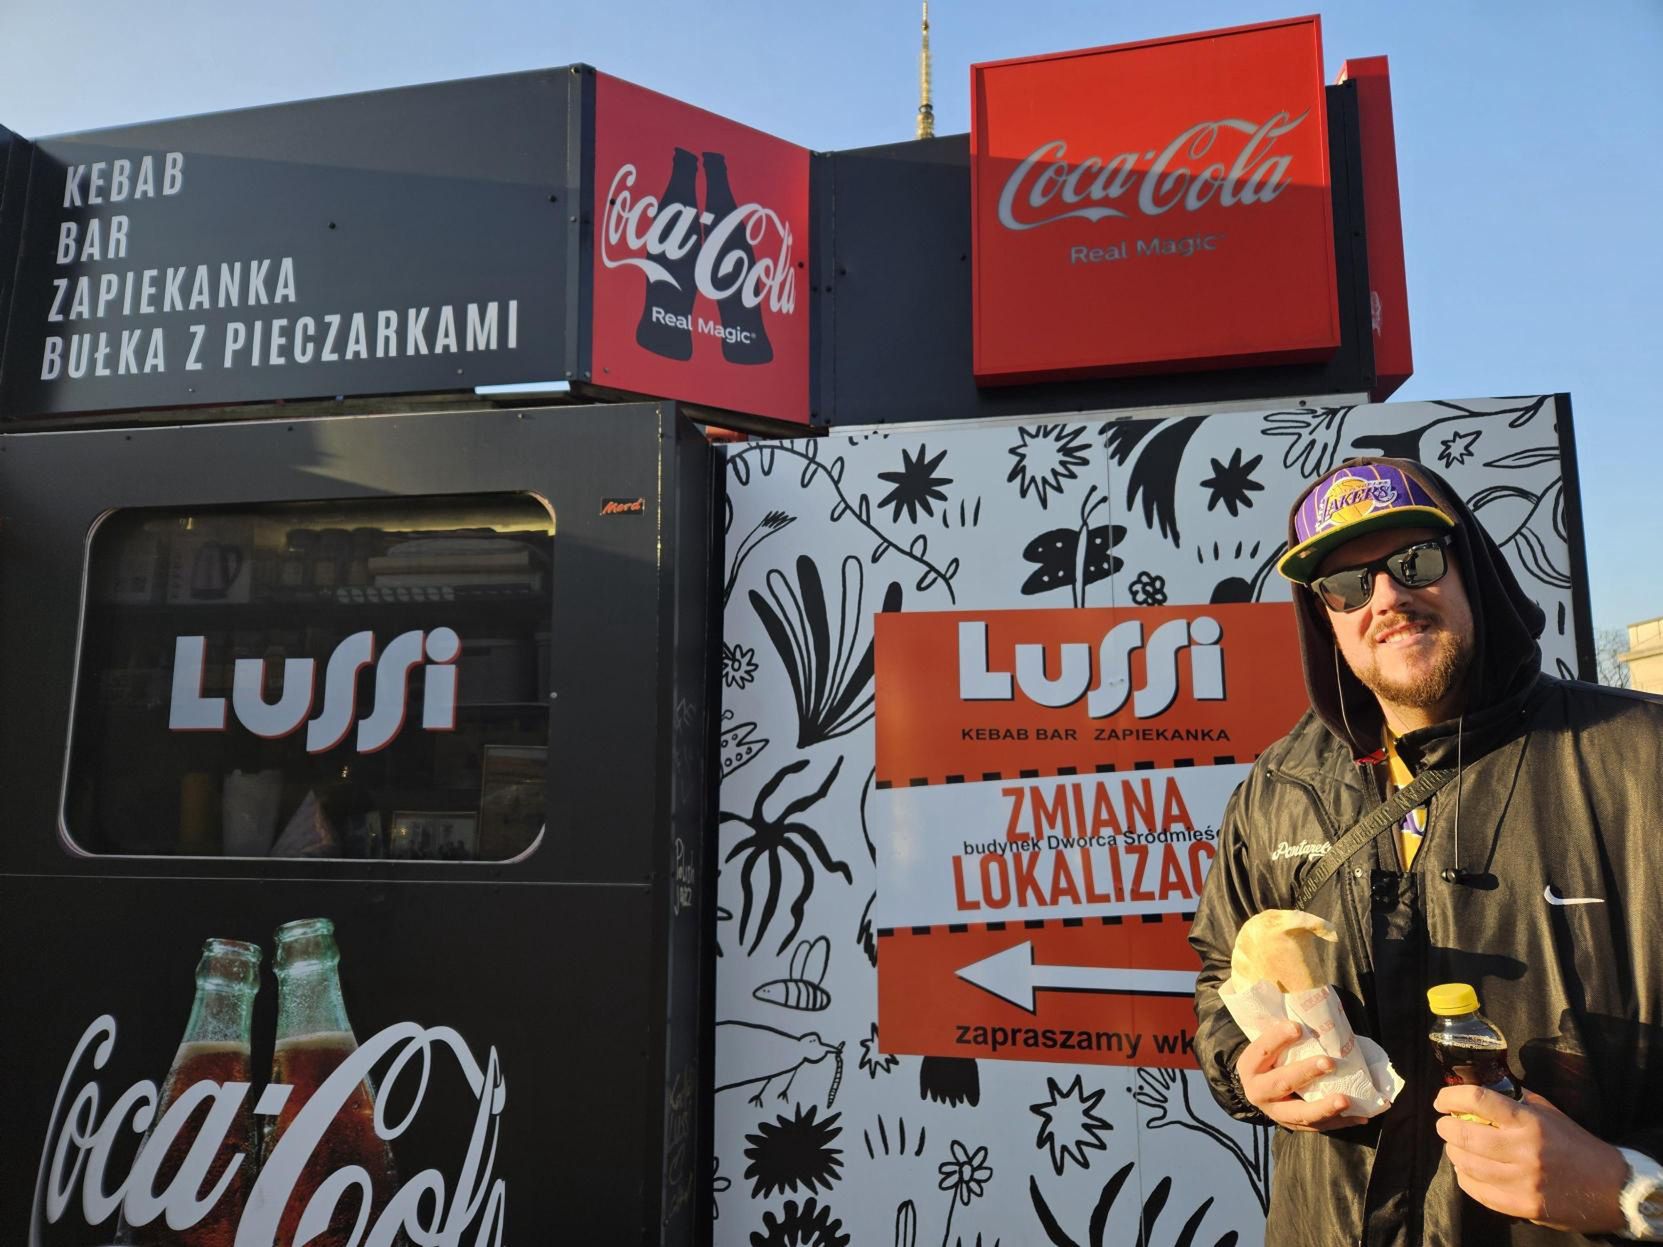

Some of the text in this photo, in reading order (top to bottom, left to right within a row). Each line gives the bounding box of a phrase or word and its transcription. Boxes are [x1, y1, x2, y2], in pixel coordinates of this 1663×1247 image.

[63, 152, 184, 208] KEBAB
[997, 108, 1311, 230] Coca-Cola
[56, 214, 130, 264] BAR
[601, 164, 796, 315] Coca-Cola
[1071, 240, 1128, 265] Real
[47, 257, 297, 322] ZAPIEKANKA
[40, 300, 518, 381] BUŁKA Z PIECZARKAMI
[652, 306, 693, 331] Real
[1316, 482, 1397, 530] LAKERS
[169, 626, 462, 753] Lussi
[958, 616, 1227, 719] Lussi
[962, 728, 1231, 741] KEBAB BAR ZAPIEKANKA
[1001, 776, 1195, 842] ZMIANA
[963, 824, 1221, 856] budynek Dworca Śródmieś
[956, 1024, 1141, 1059] zapraszamy
